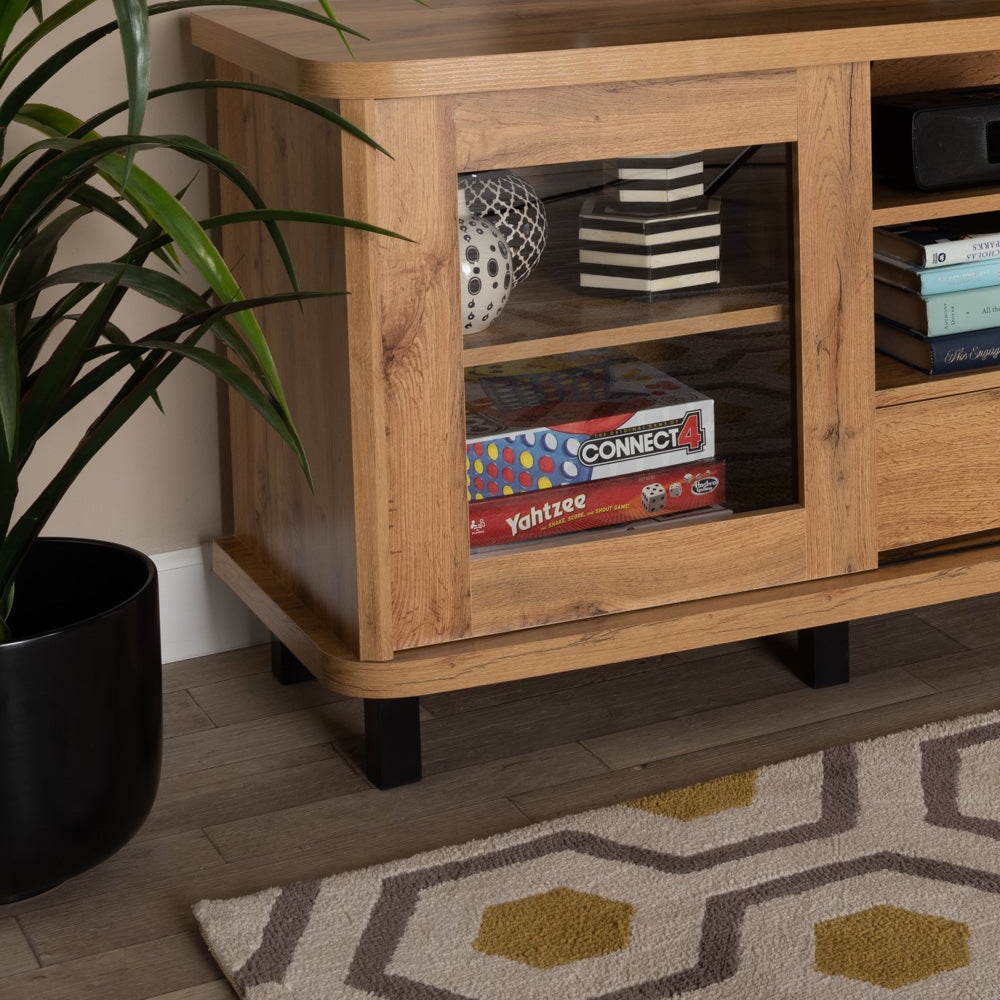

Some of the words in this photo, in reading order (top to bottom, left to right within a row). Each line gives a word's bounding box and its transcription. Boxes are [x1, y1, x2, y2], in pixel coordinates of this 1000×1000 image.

[982, 306, 991, 315] All
[944, 348, 968, 364] The
[610, 425, 646, 436] ORIGINAL
[648, 422, 668, 430] GAME
[582, 428, 679, 462] CONNECT
[678, 414, 702, 450] 4
[505, 493, 587, 536] Yahtzee
[595, 505, 614, 514] SHOUT
